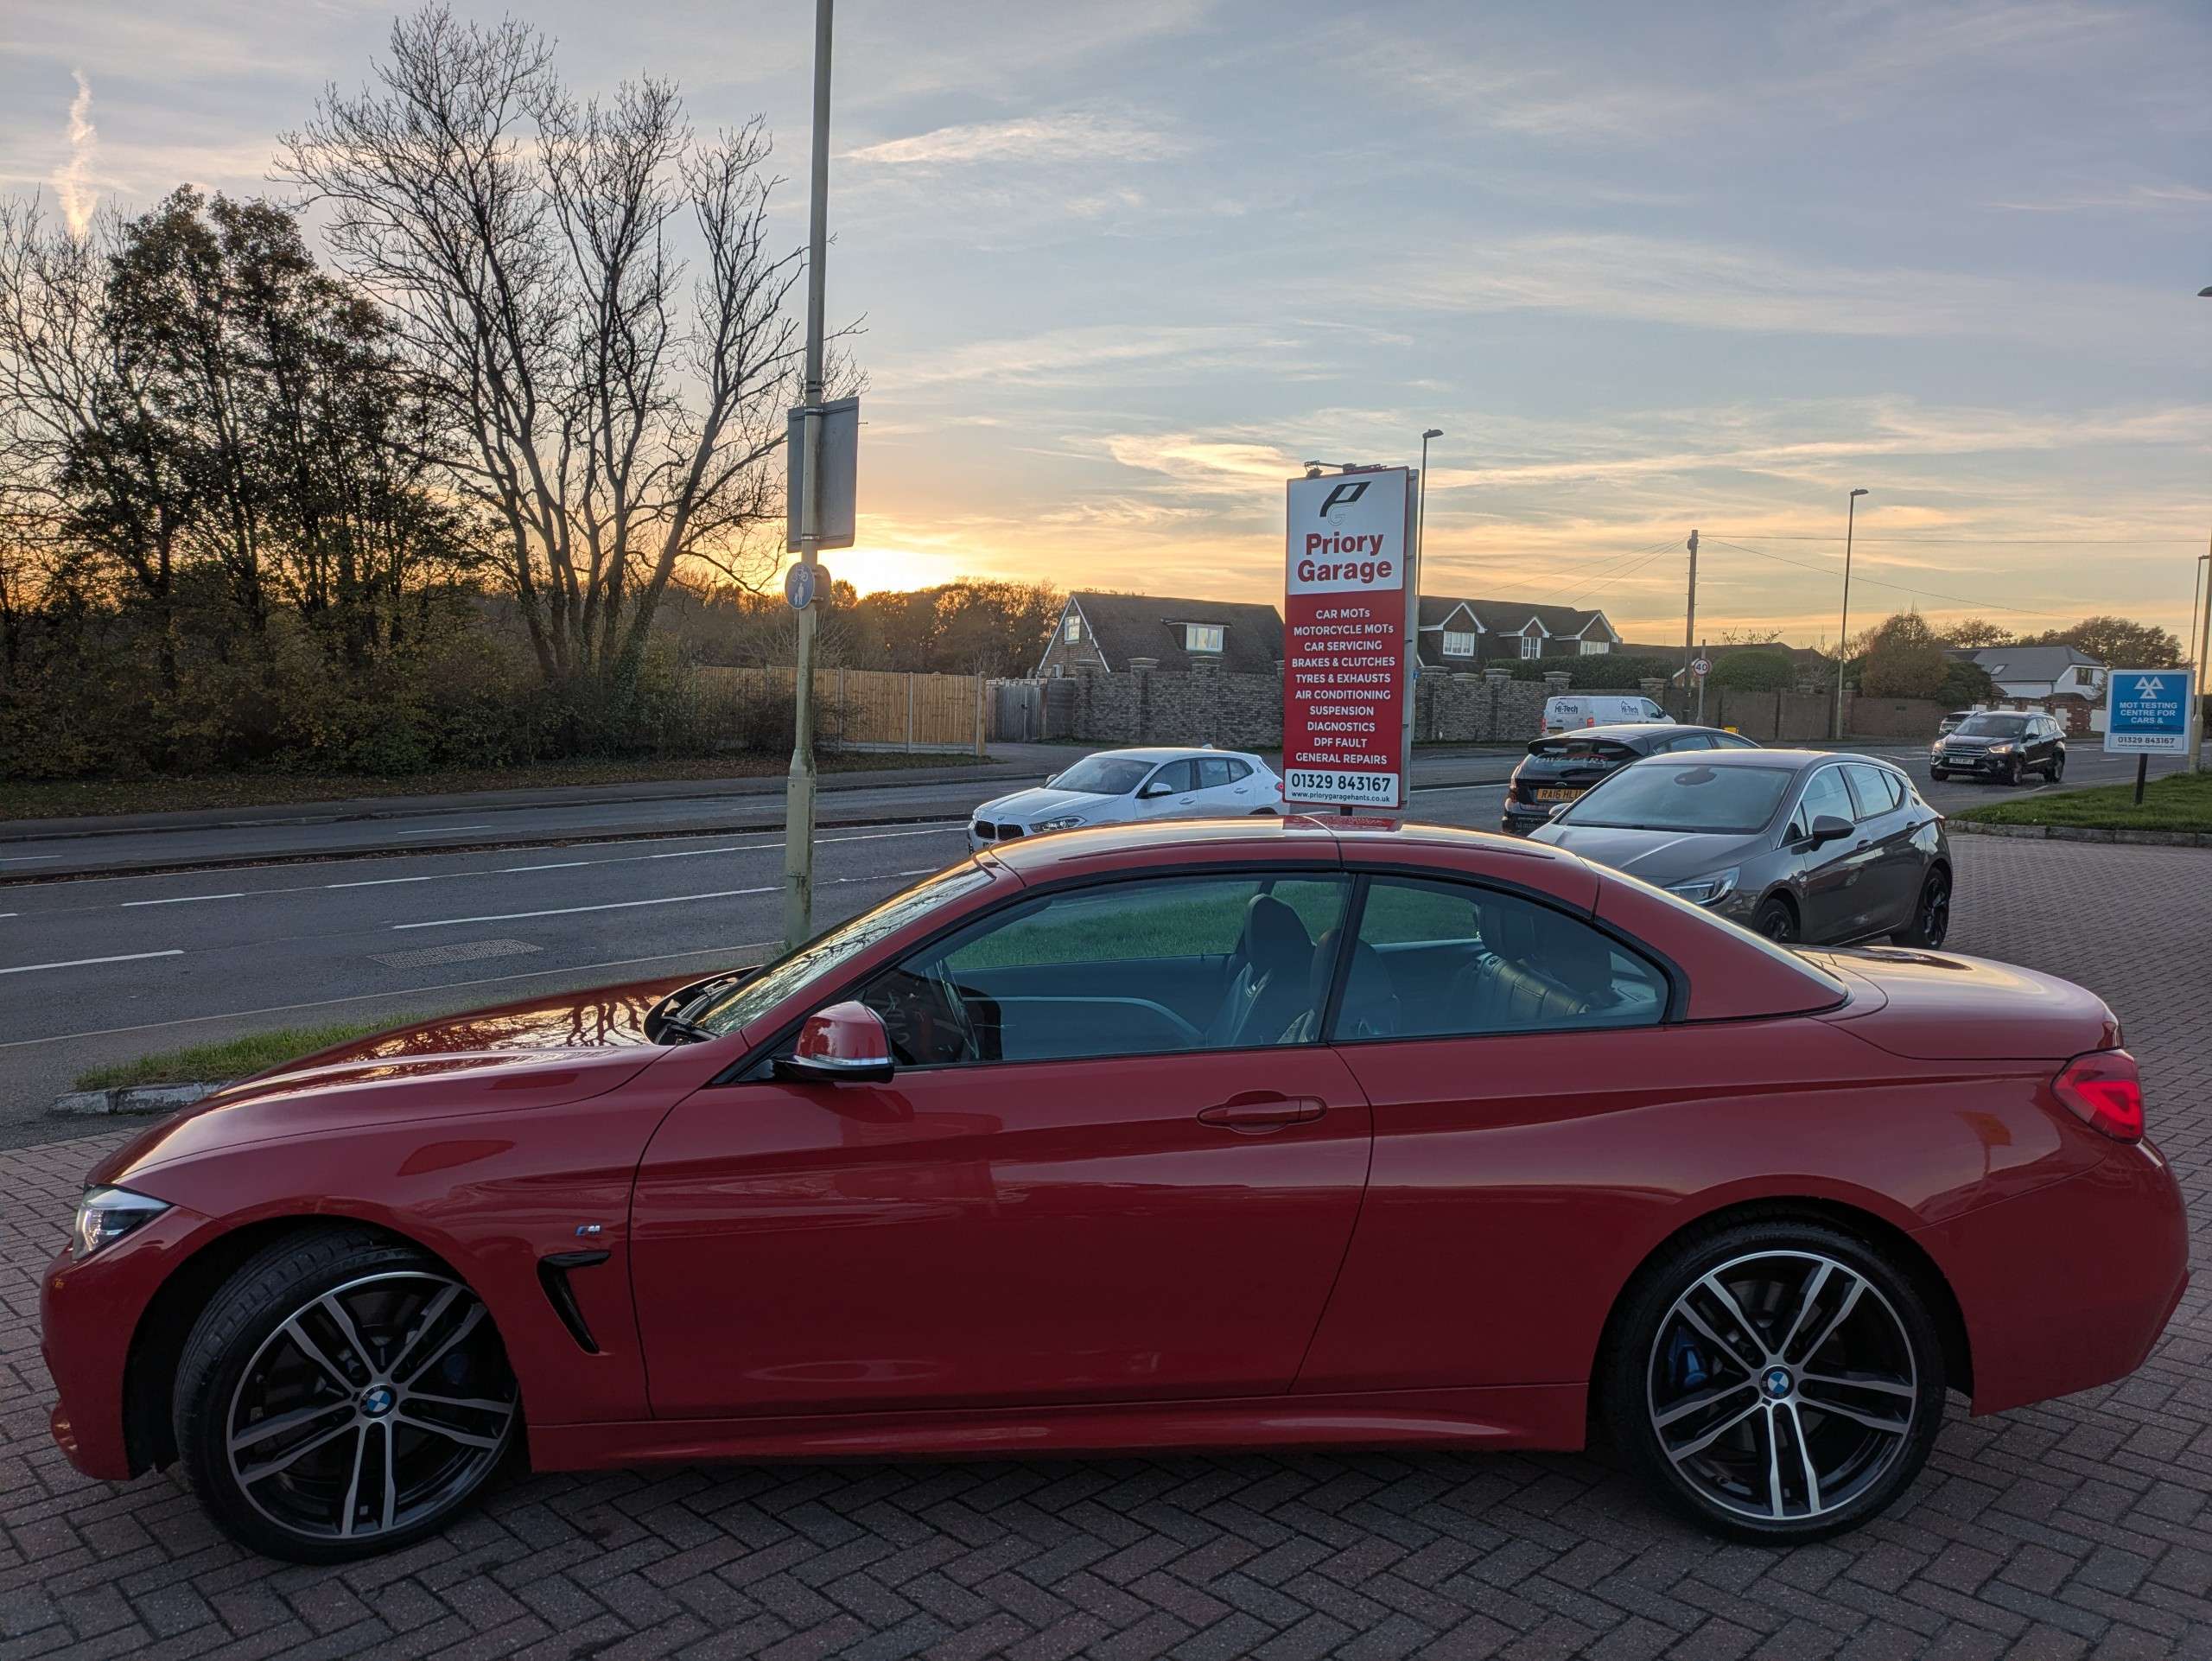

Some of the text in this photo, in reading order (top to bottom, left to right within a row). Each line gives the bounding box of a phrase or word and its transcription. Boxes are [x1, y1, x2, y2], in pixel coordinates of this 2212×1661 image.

[1306, 531, 1383, 556] Priory
[1297, 559, 1392, 583] Garage
[1316, 608, 1370, 620] CAR MOTs
[1294, 623, 1394, 636] MOTORCYCLE MOTs
[1304, 640, 1382, 652] CAR SERVICING
[1292, 657, 1395, 667] BRAKES & CLUTCHES
[1295, 673, 1391, 684] TYRES & EXHAUSTS
[1295, 690, 1391, 700] AIR CONDITIONING
[1309, 705, 1374, 716] SUSPENSION
[1307, 722, 1376, 732] DIAGNOSTICS
[1313, 737, 1367, 748] DPF FAULT
[1296, 753, 1388, 765] GENERAL REPAIRS
[1291, 773, 1391, 792] 01329 843167
[1291, 791, 1390, 803] www.priorygaragehants.co.uk
